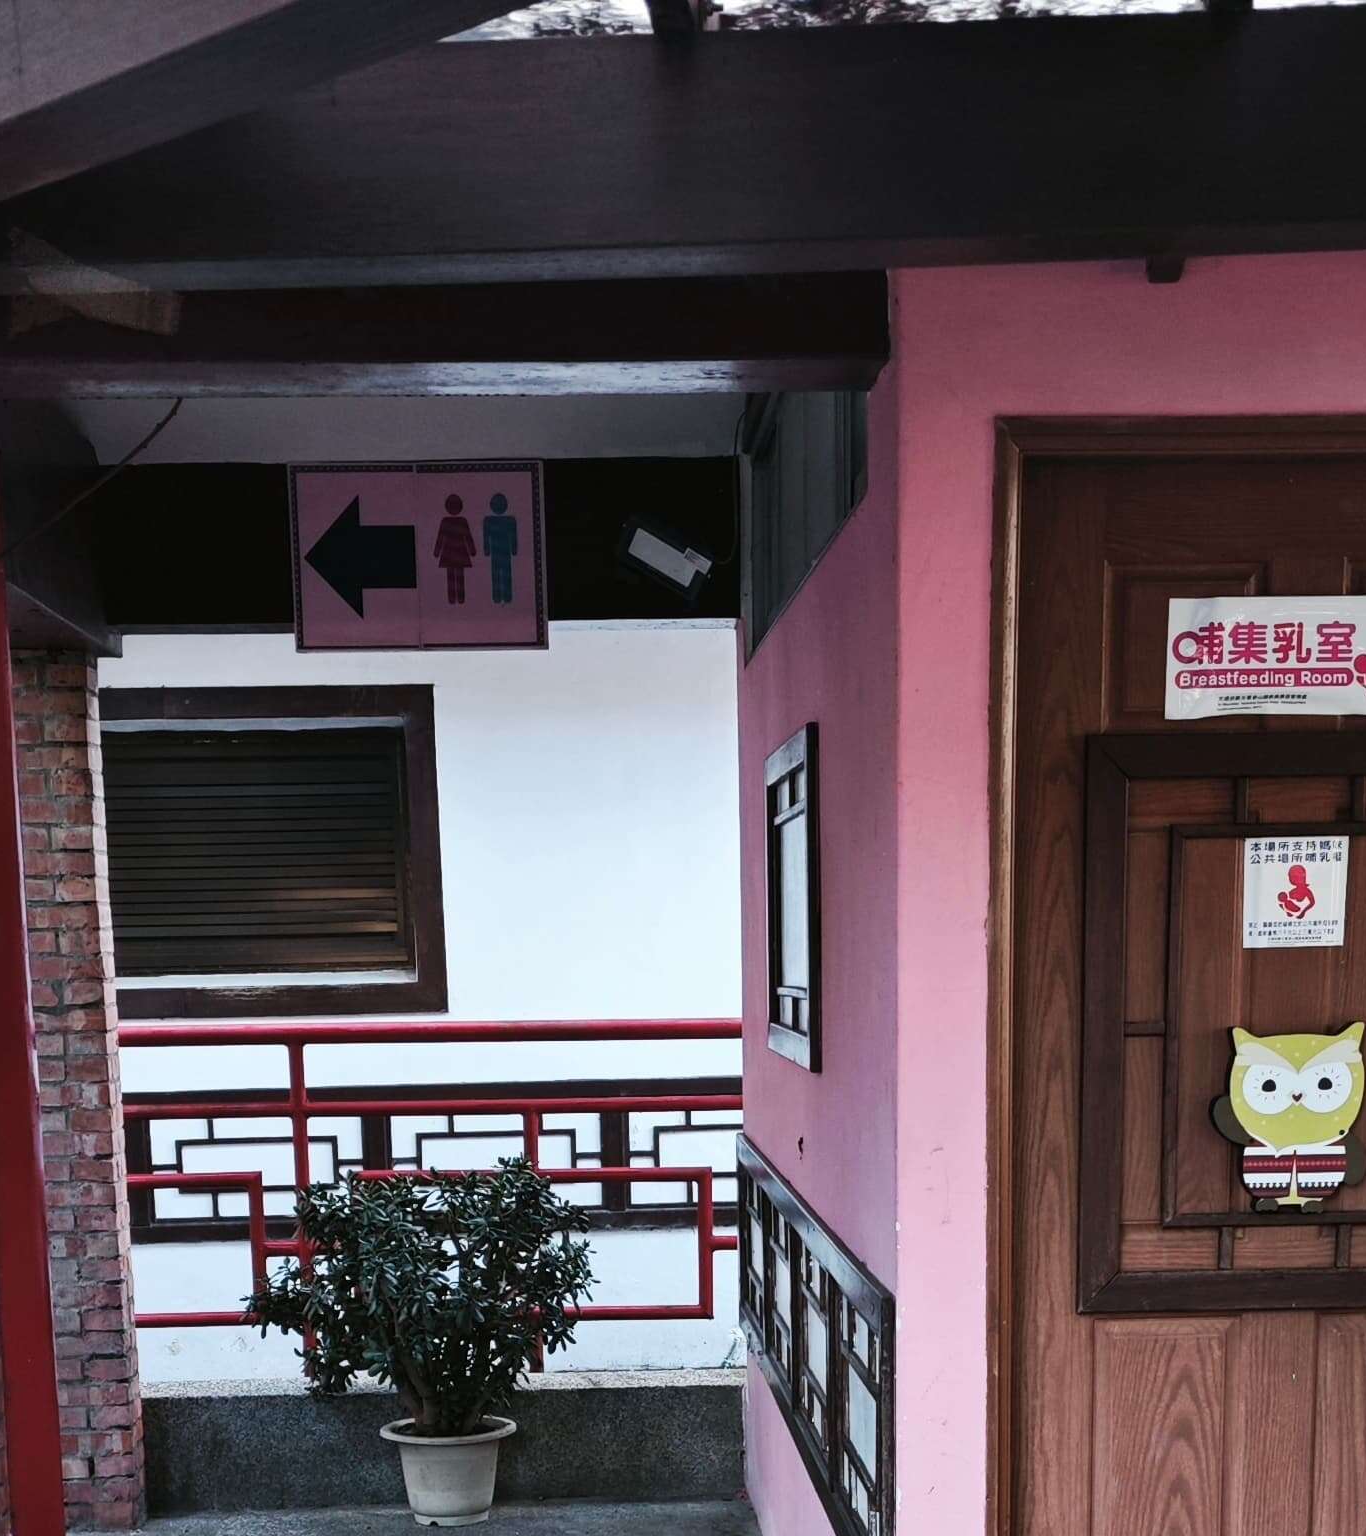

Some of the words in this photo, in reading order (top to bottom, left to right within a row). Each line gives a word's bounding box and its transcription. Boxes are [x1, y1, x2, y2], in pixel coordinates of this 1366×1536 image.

[1172, 620, 1357, 664] 哺集乳室
[1179, 670, 1295, 686] Breastfeeding
[1301, 670, 1348, 685] Room
